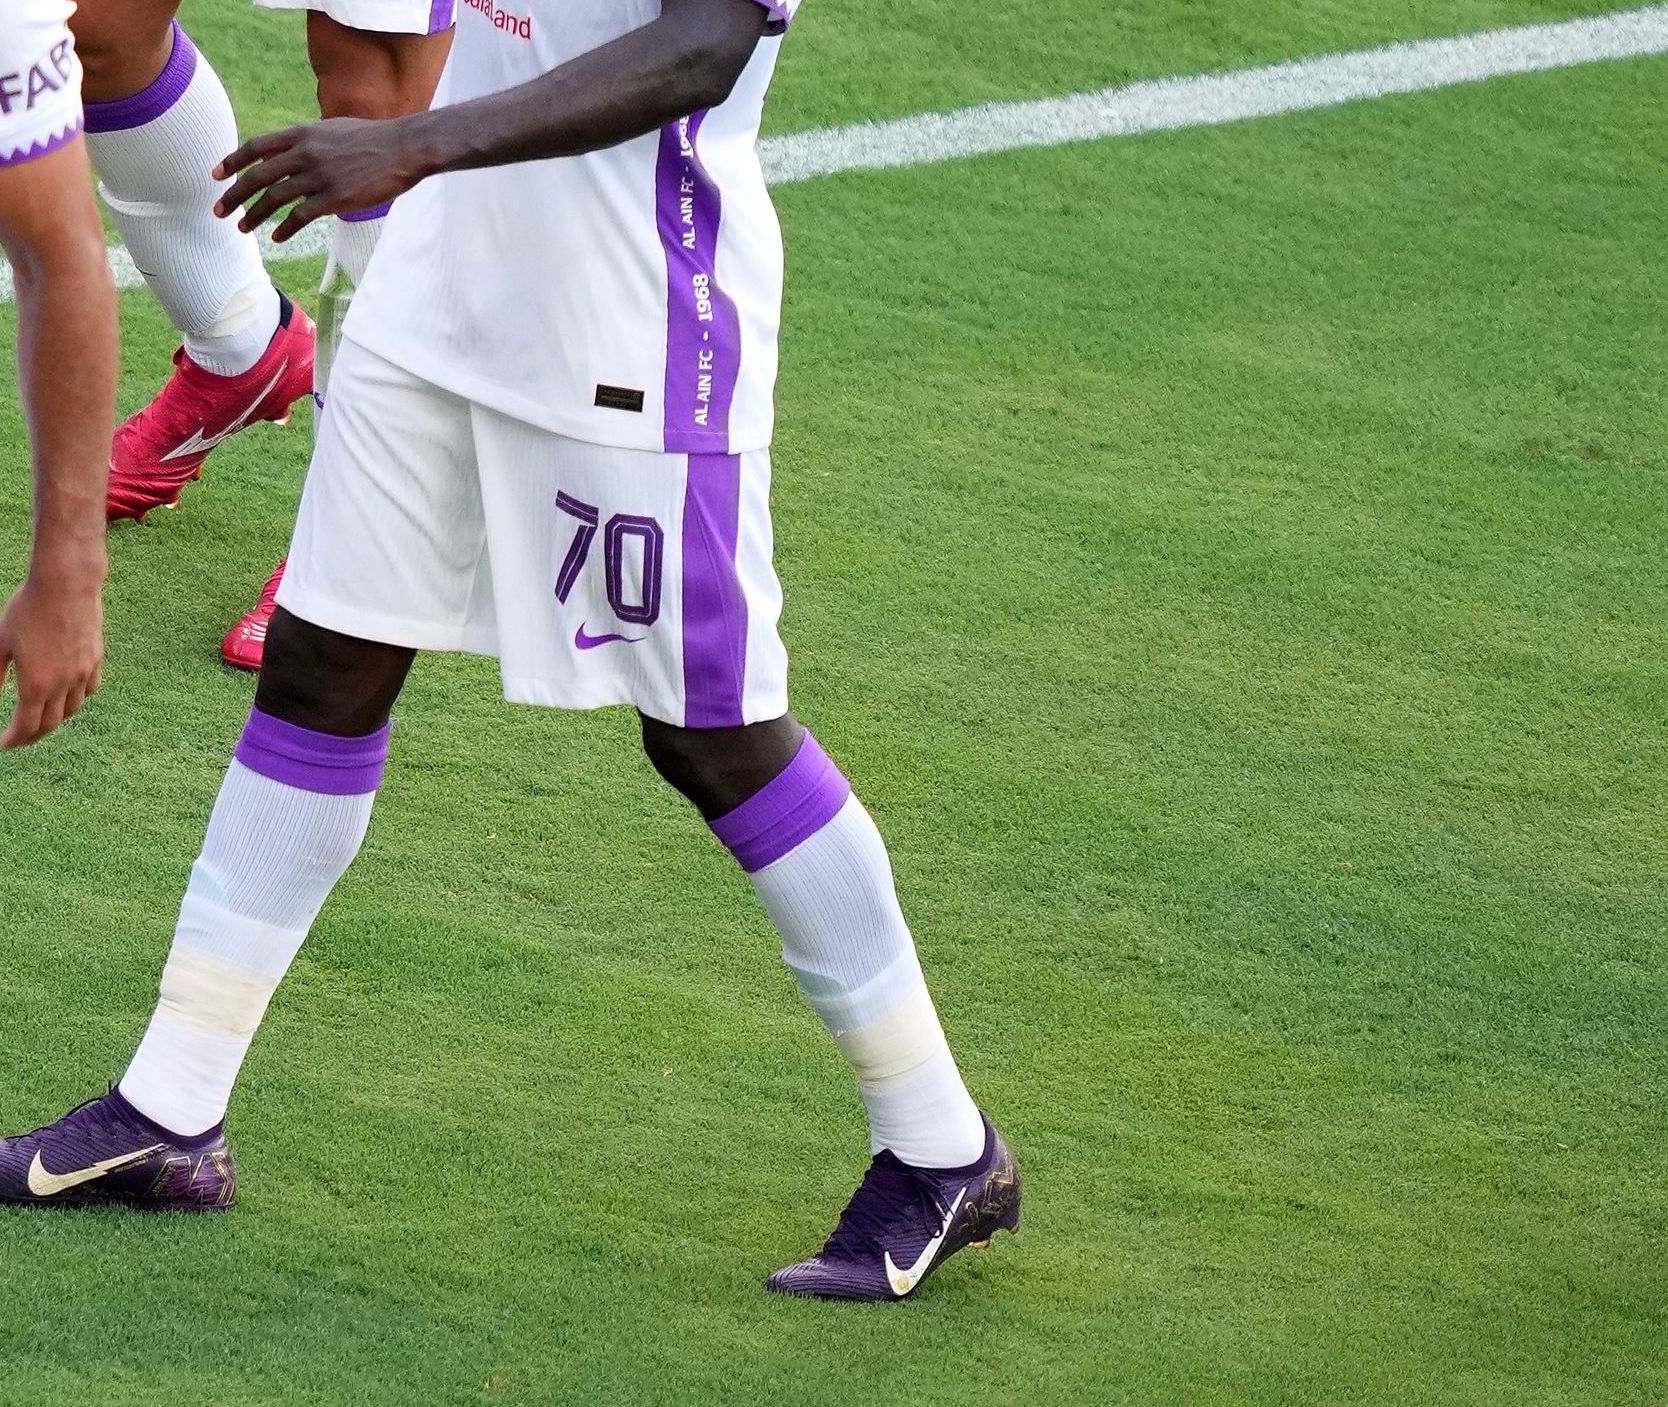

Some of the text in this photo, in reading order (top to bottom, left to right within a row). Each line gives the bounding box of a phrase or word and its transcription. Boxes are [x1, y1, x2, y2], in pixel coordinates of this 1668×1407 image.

[495, 8, 531, 40] and
[681, 177, 694, 193] FC
[681, 197, 694, 226] AIN
[683, 227, 695, 250] AL
[693, 273, 714, 322] 1968
[698, 349, 714, 370] FC
[695, 375, 713, 403] AIN
[694, 403, 709, 426] AL
[554, 489, 664, 627] 70
